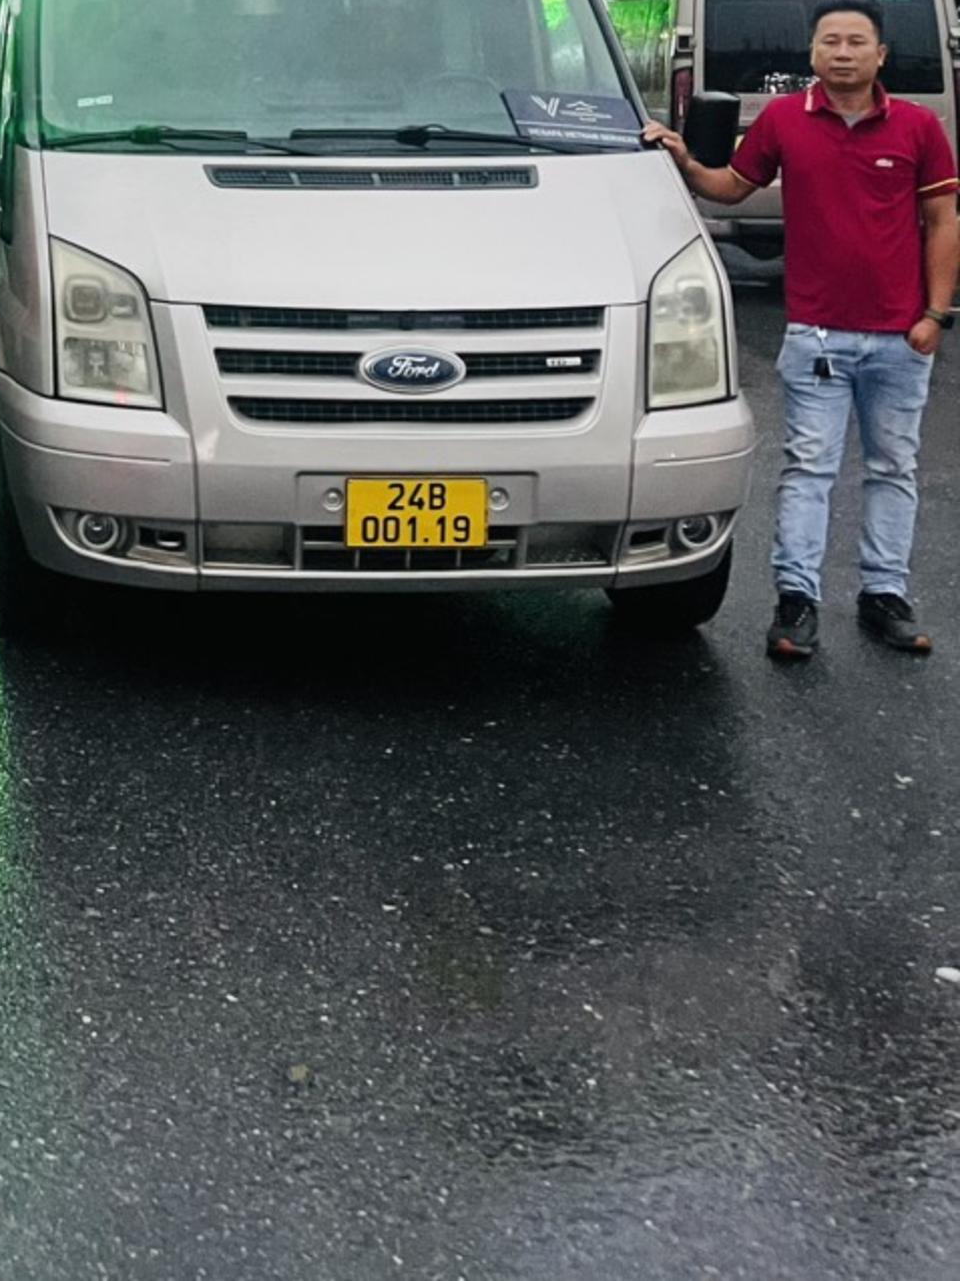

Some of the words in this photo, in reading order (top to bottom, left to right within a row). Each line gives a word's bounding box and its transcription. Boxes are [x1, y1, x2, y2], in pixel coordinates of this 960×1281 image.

[388, 355, 441, 378] Ford
[387, 482, 447, 511] 24B
[360, 515, 471, 543] 001.19
